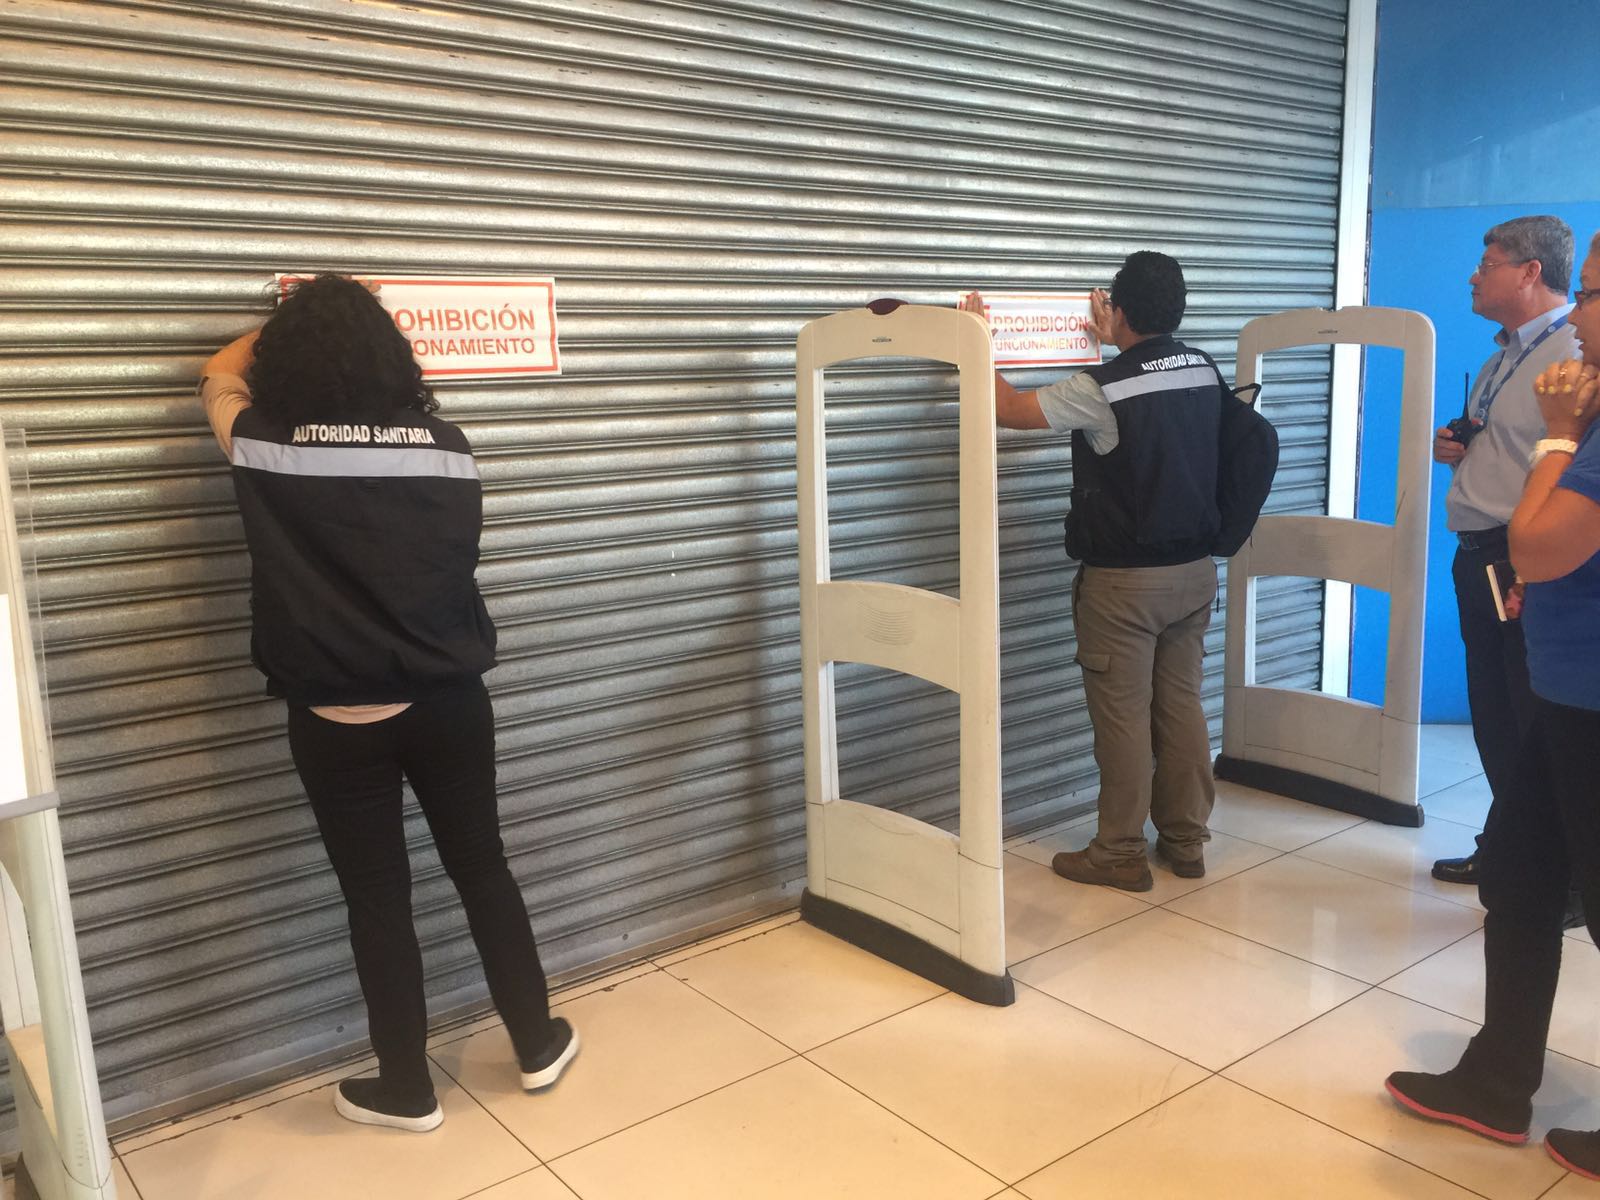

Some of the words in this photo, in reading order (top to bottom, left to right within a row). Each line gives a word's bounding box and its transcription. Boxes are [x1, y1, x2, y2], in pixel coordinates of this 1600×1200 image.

[387, 303, 535, 331] OHIBICIÓN
[413, 338, 535, 356] ONAMIENTO
[994, 337, 1088, 351] UNCIONAMIENTO
[1141, 354, 1187, 371] AUTORIDAD
[292, 424, 370, 443] AUTORIDAD
[373, 425, 436, 444] SANITARIA
